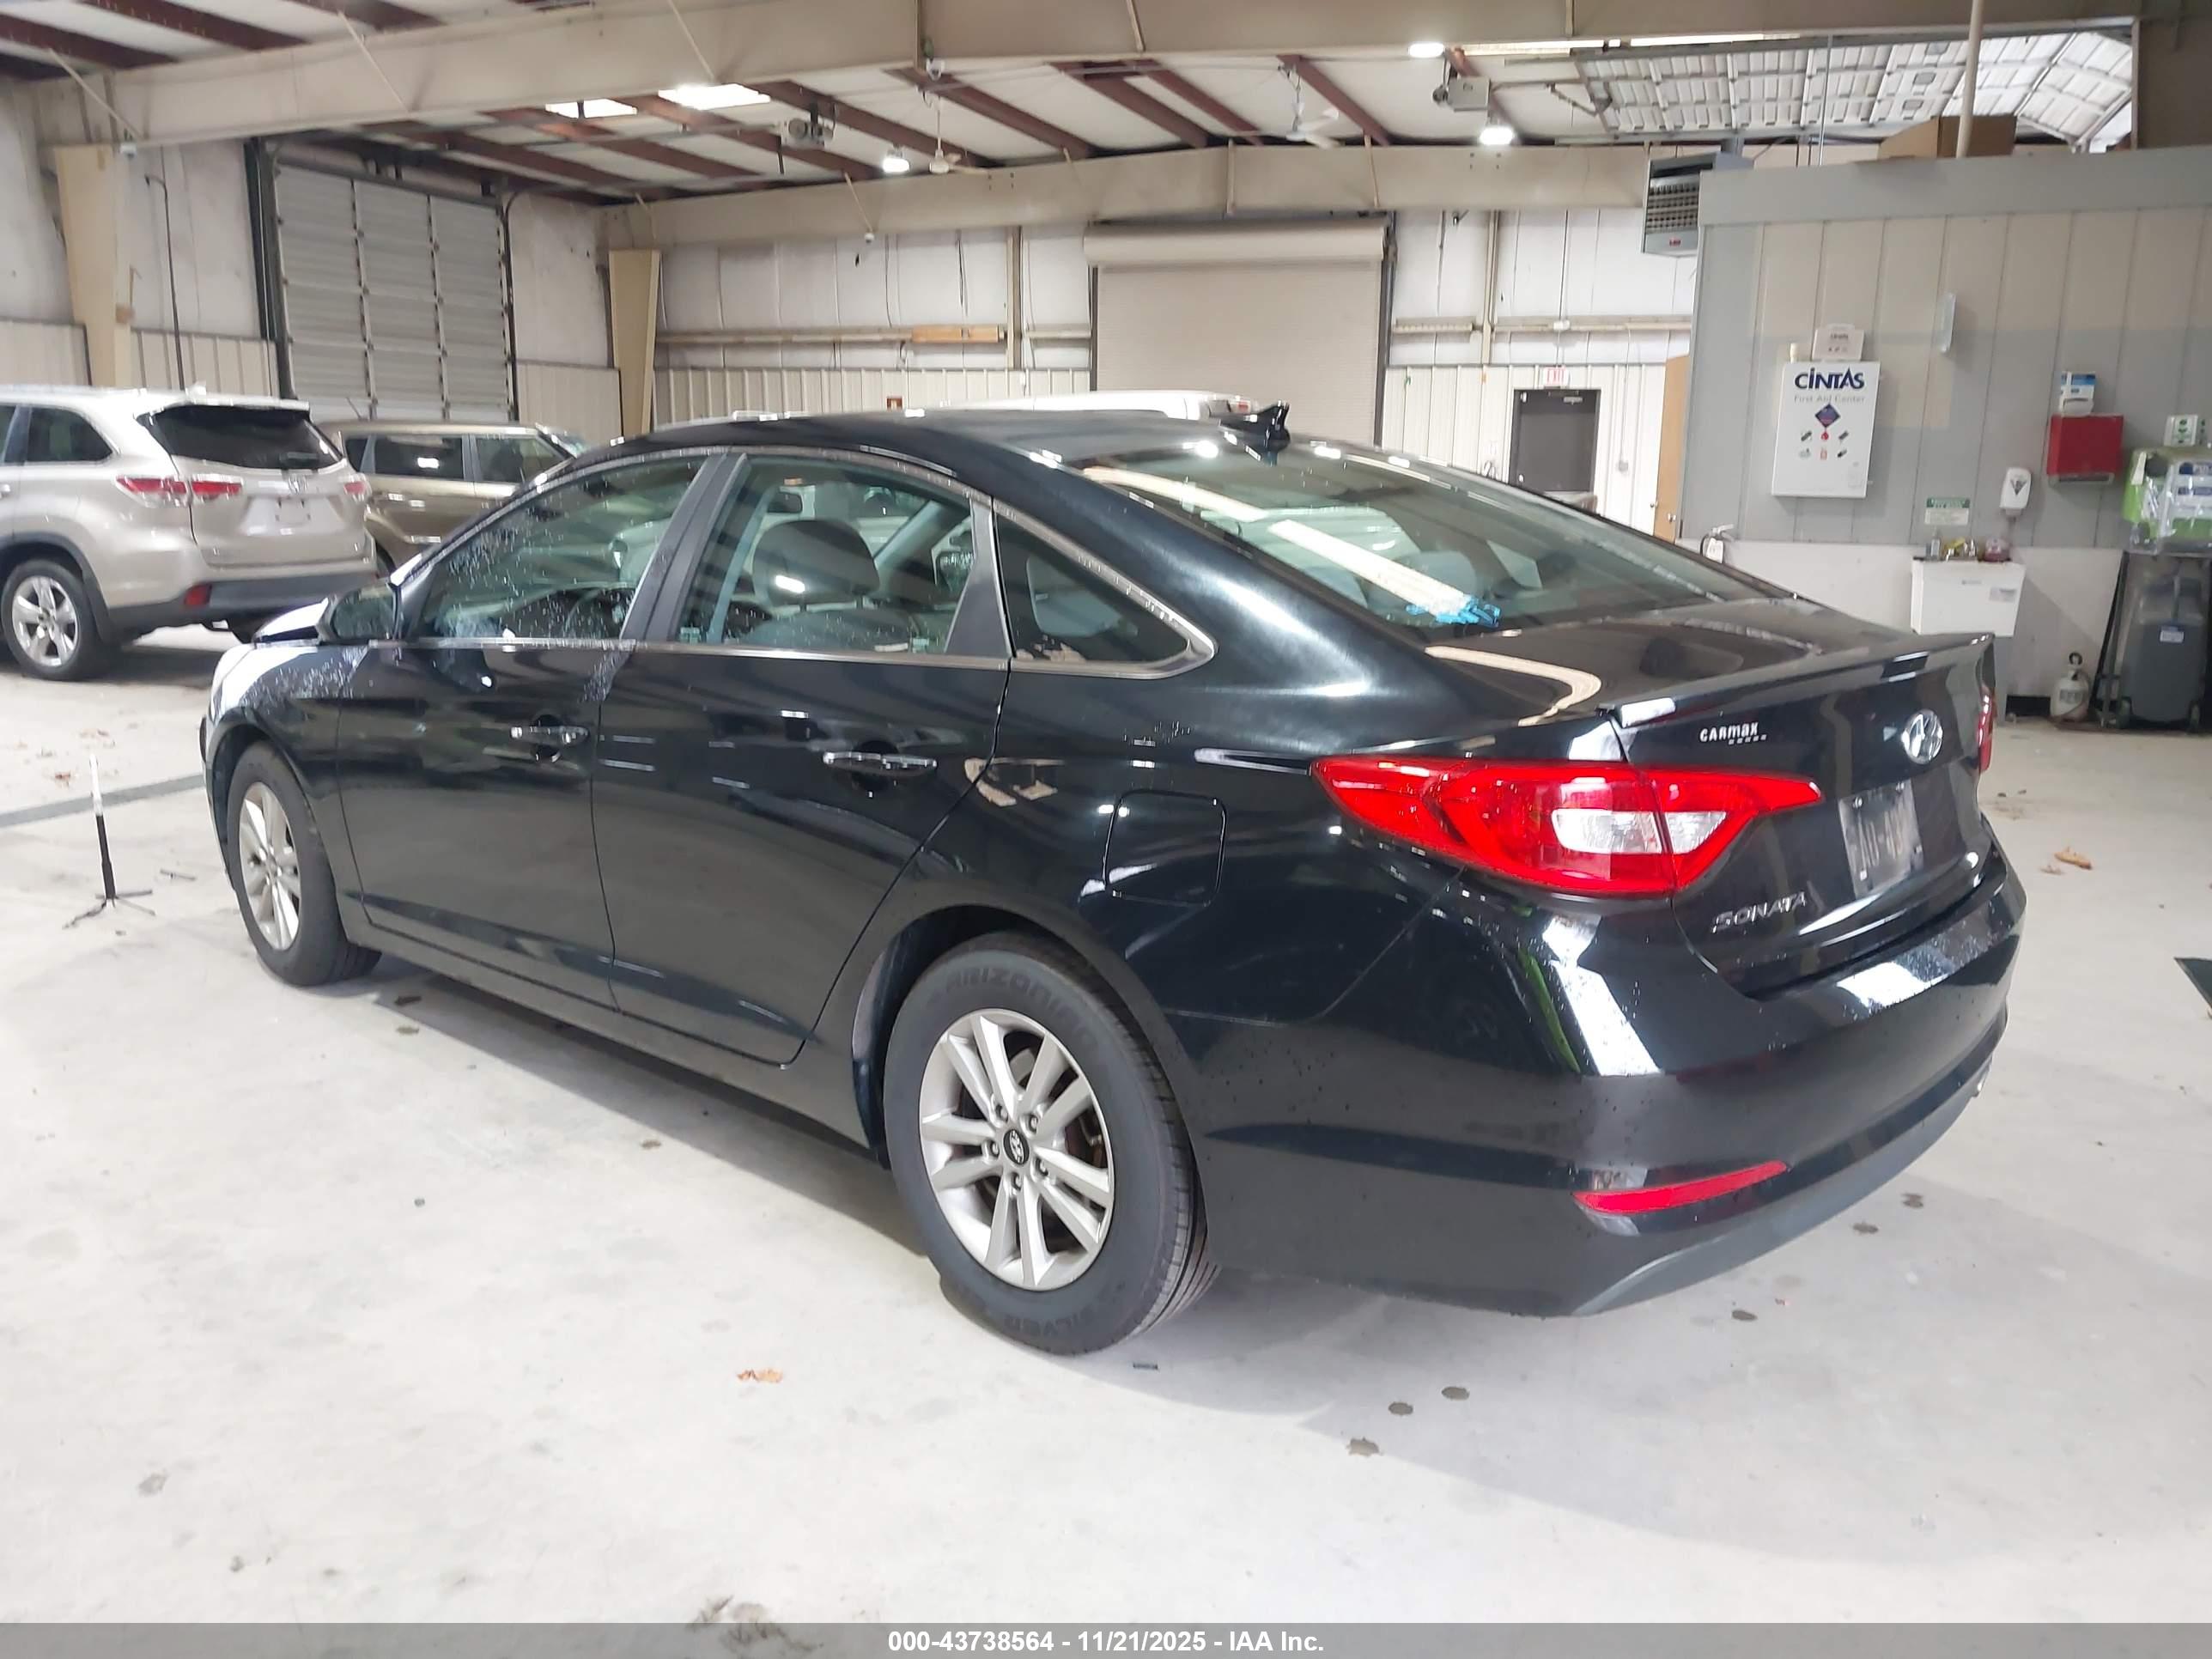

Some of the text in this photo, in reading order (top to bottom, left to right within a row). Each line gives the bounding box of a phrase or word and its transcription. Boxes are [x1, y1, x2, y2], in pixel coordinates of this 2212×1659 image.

[1816, 394, 1832, 403] Aid
[1835, 394, 1865, 404] Center
[1711, 891, 1806, 933] SONATA
